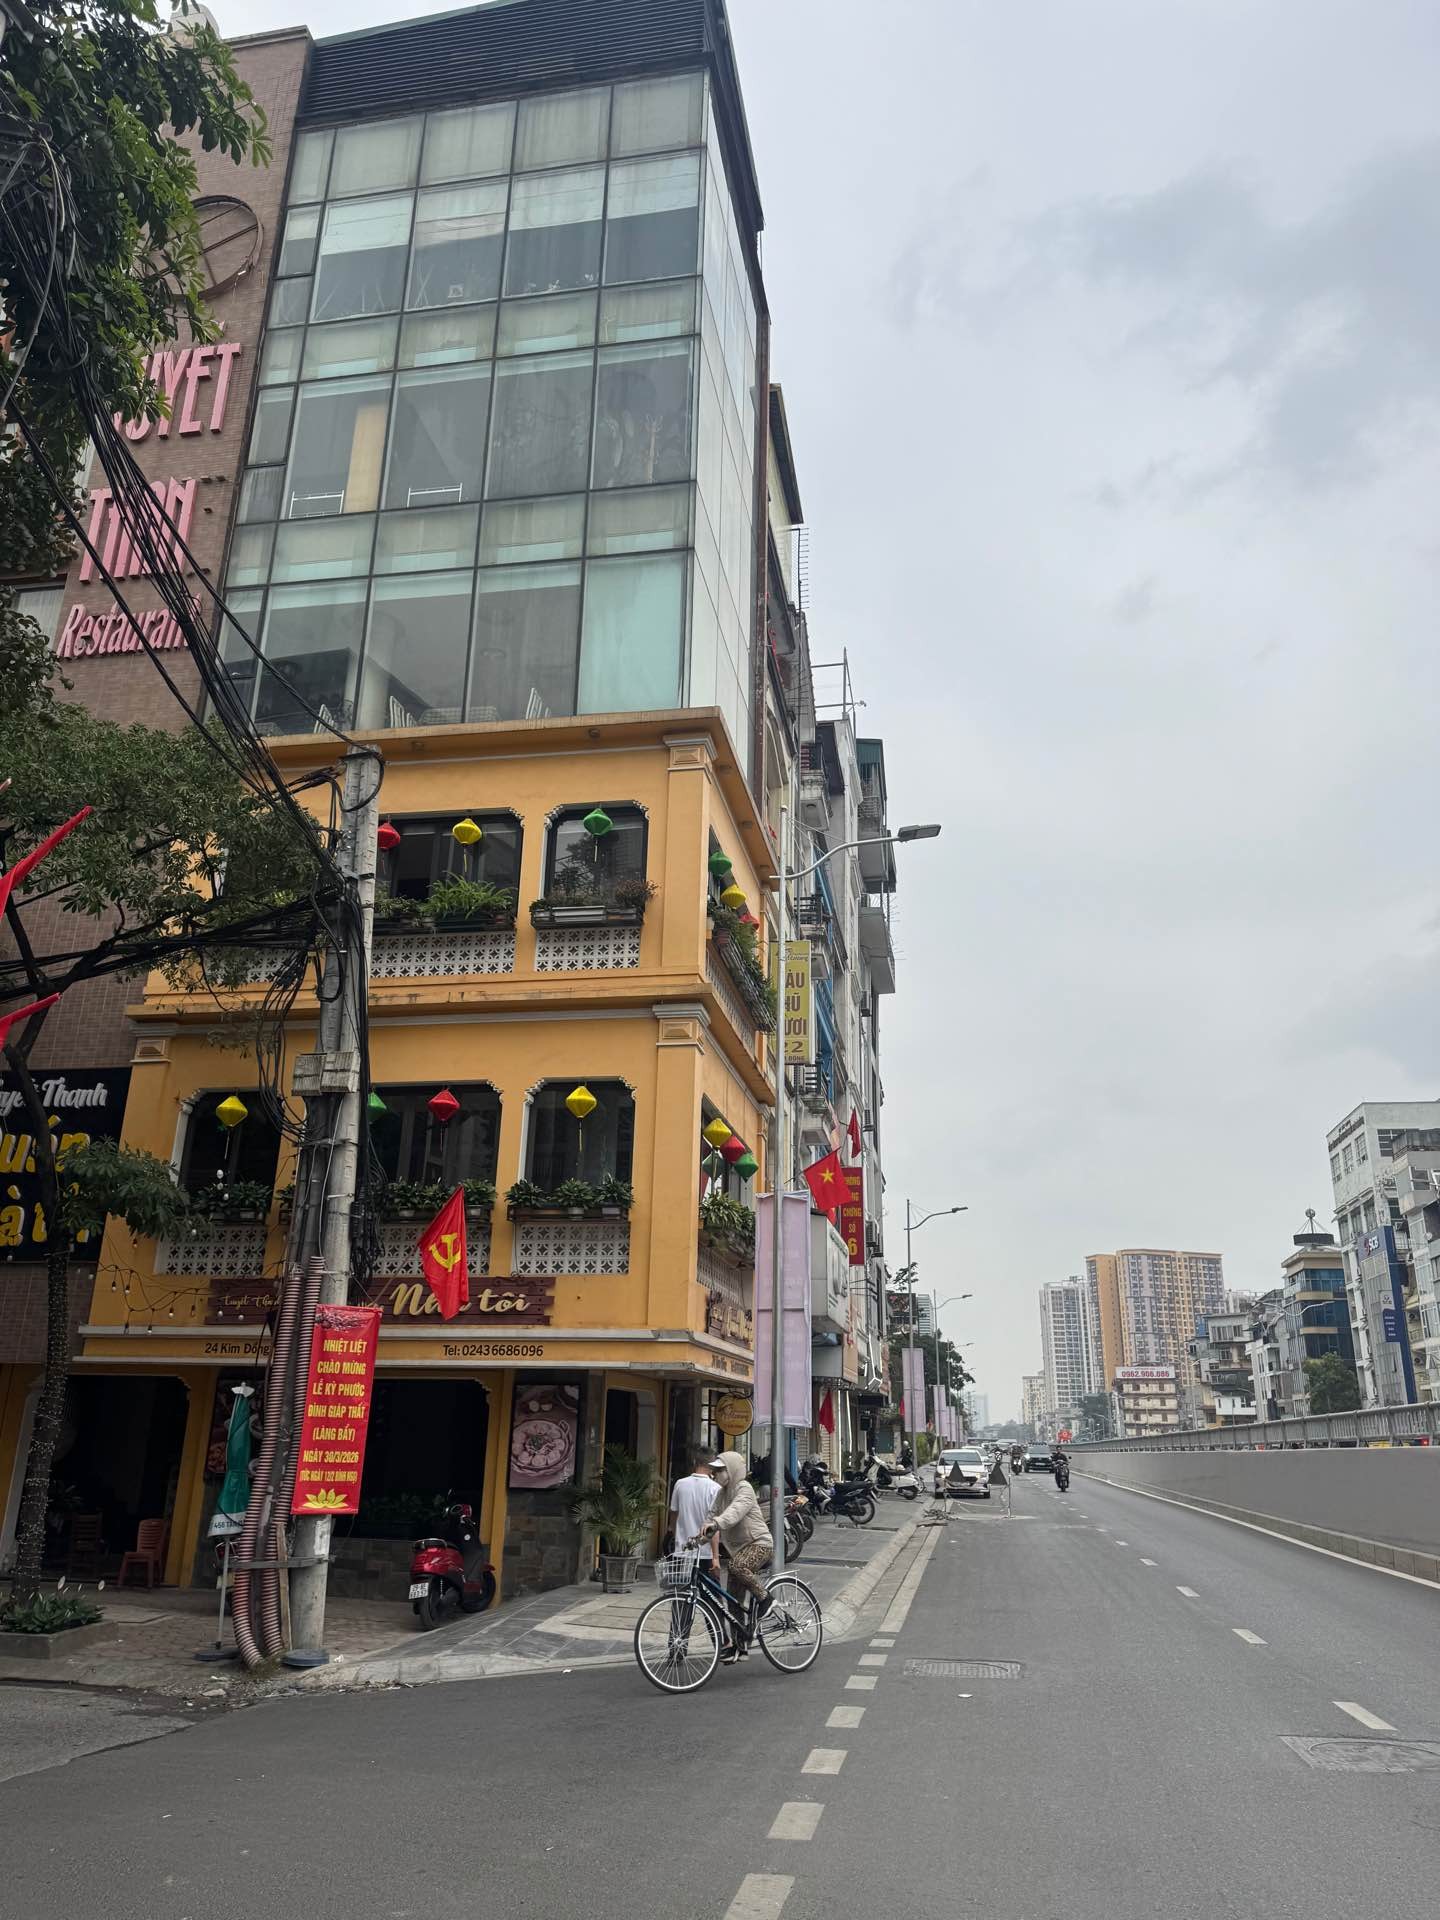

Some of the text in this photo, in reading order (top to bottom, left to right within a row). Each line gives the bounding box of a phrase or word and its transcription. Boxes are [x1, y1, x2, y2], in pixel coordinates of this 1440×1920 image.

[43, 1077, 108, 1108] Thanh
[848, 1237, 858, 1256] 6
[205, 1343, 218, 1354] 24
[221, 1343, 240, 1354] Kim
[323, 1338, 368, 1356] NHIỆT LIỆT
[462, 1345, 544, 1357] 02436686096
[317, 1359, 367, 1375] CHÀO MỪNG
[312, 1378, 325, 1395] LỄ
[325, 1381, 337, 1396] KỲ
[308, 1403, 327, 1417] ĐÌNH
[328, 1404, 347, 1418] GIÁP
[312, 1425, 337, 1441] (LÀNG
[303, 1448, 359, 1464] NGÀY 30/3/2026
